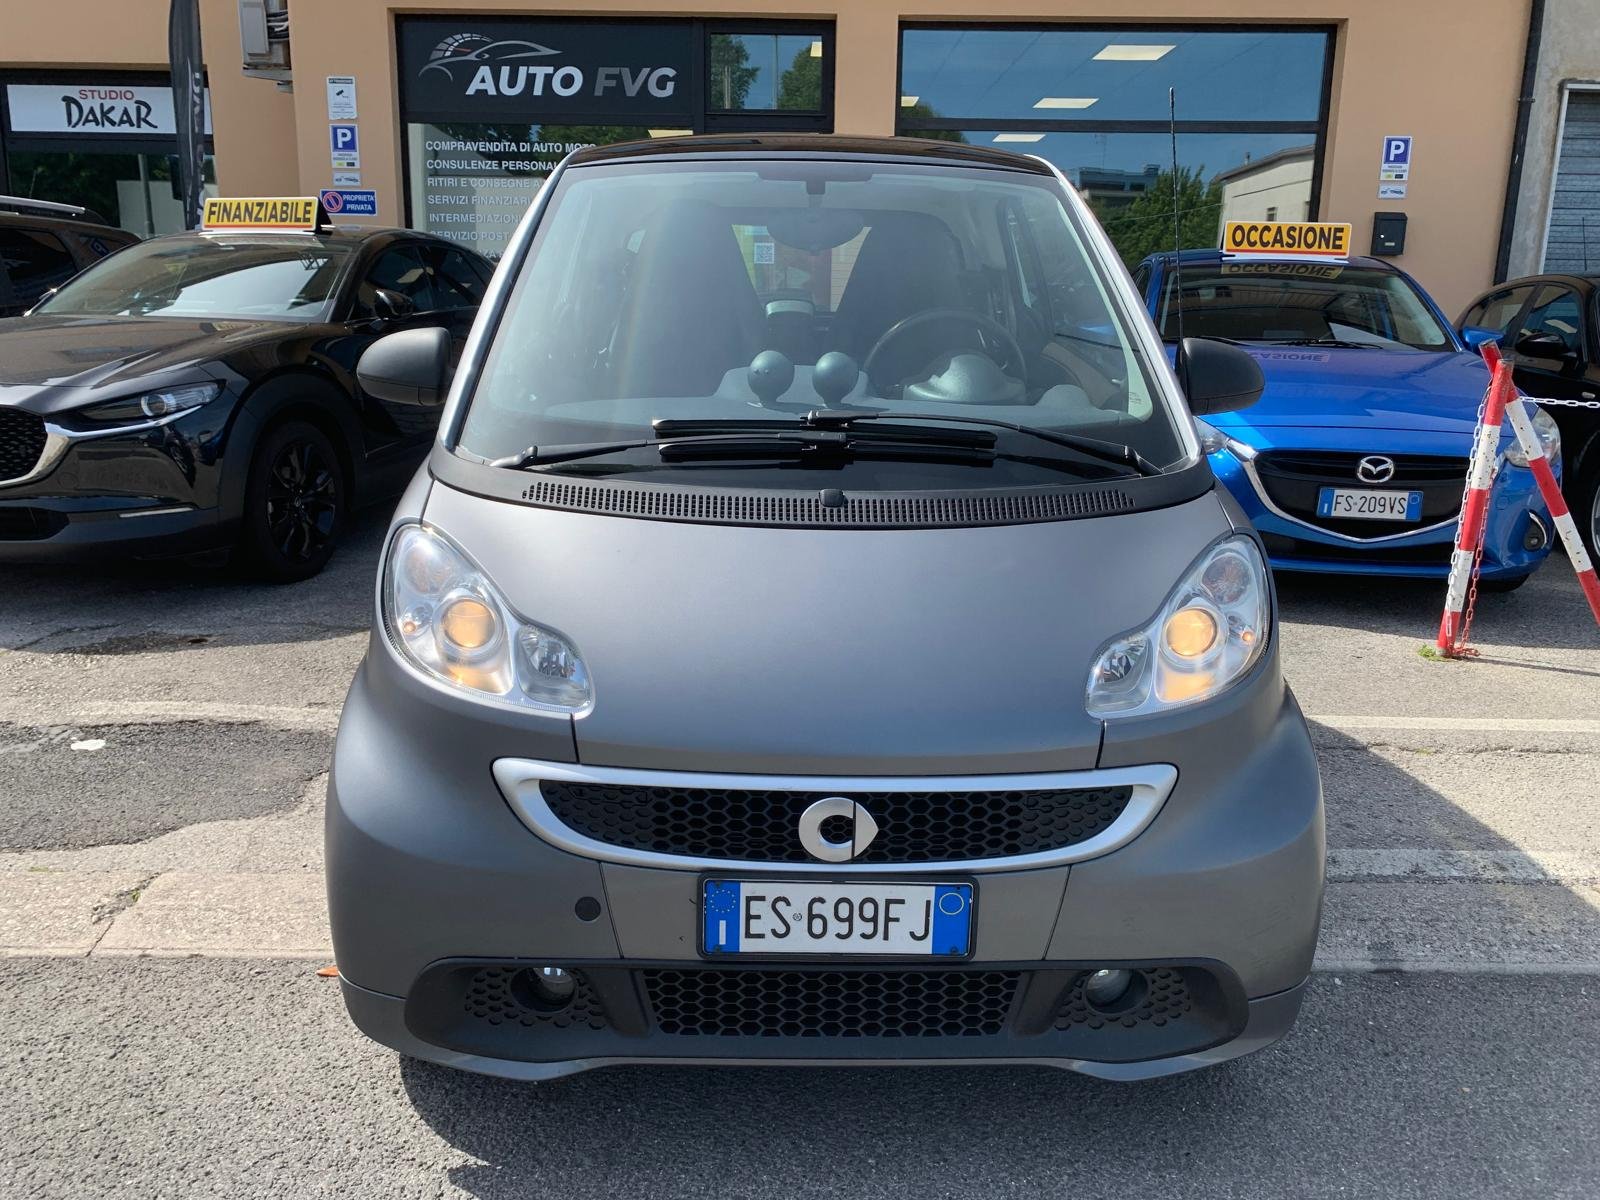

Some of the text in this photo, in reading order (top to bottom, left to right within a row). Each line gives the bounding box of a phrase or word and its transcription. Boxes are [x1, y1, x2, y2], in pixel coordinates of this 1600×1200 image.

[465, 65, 678, 98] AUTO FVG
[78, 89, 135, 101] STUDIO
[61, 95, 158, 129] DAKAR
[336, 128, 352, 149] P
[425, 141, 518, 152] COMPRAVENDITA
[519, 142, 531, 153] DI
[532, 143, 562, 153] AUTO
[1389, 140, 1405, 161] P
[426, 160, 499, 170] CONSULENZE
[427, 177, 458, 187] RITIRI
[460, 178, 467, 187] E
[470, 178, 530, 188] CONSEGNE
[346, 203, 373, 211] PRIVATA
[427, 195, 531, 206] SERVIZI FINANZIARI
[207, 201, 313, 223] FINANZIABILE
[481, 231, 509, 241] POST
[1231, 224, 1345, 250] OCCASIONE
[744, 895, 792, 939] ES
[807, 896, 931, 941] 699FJ
